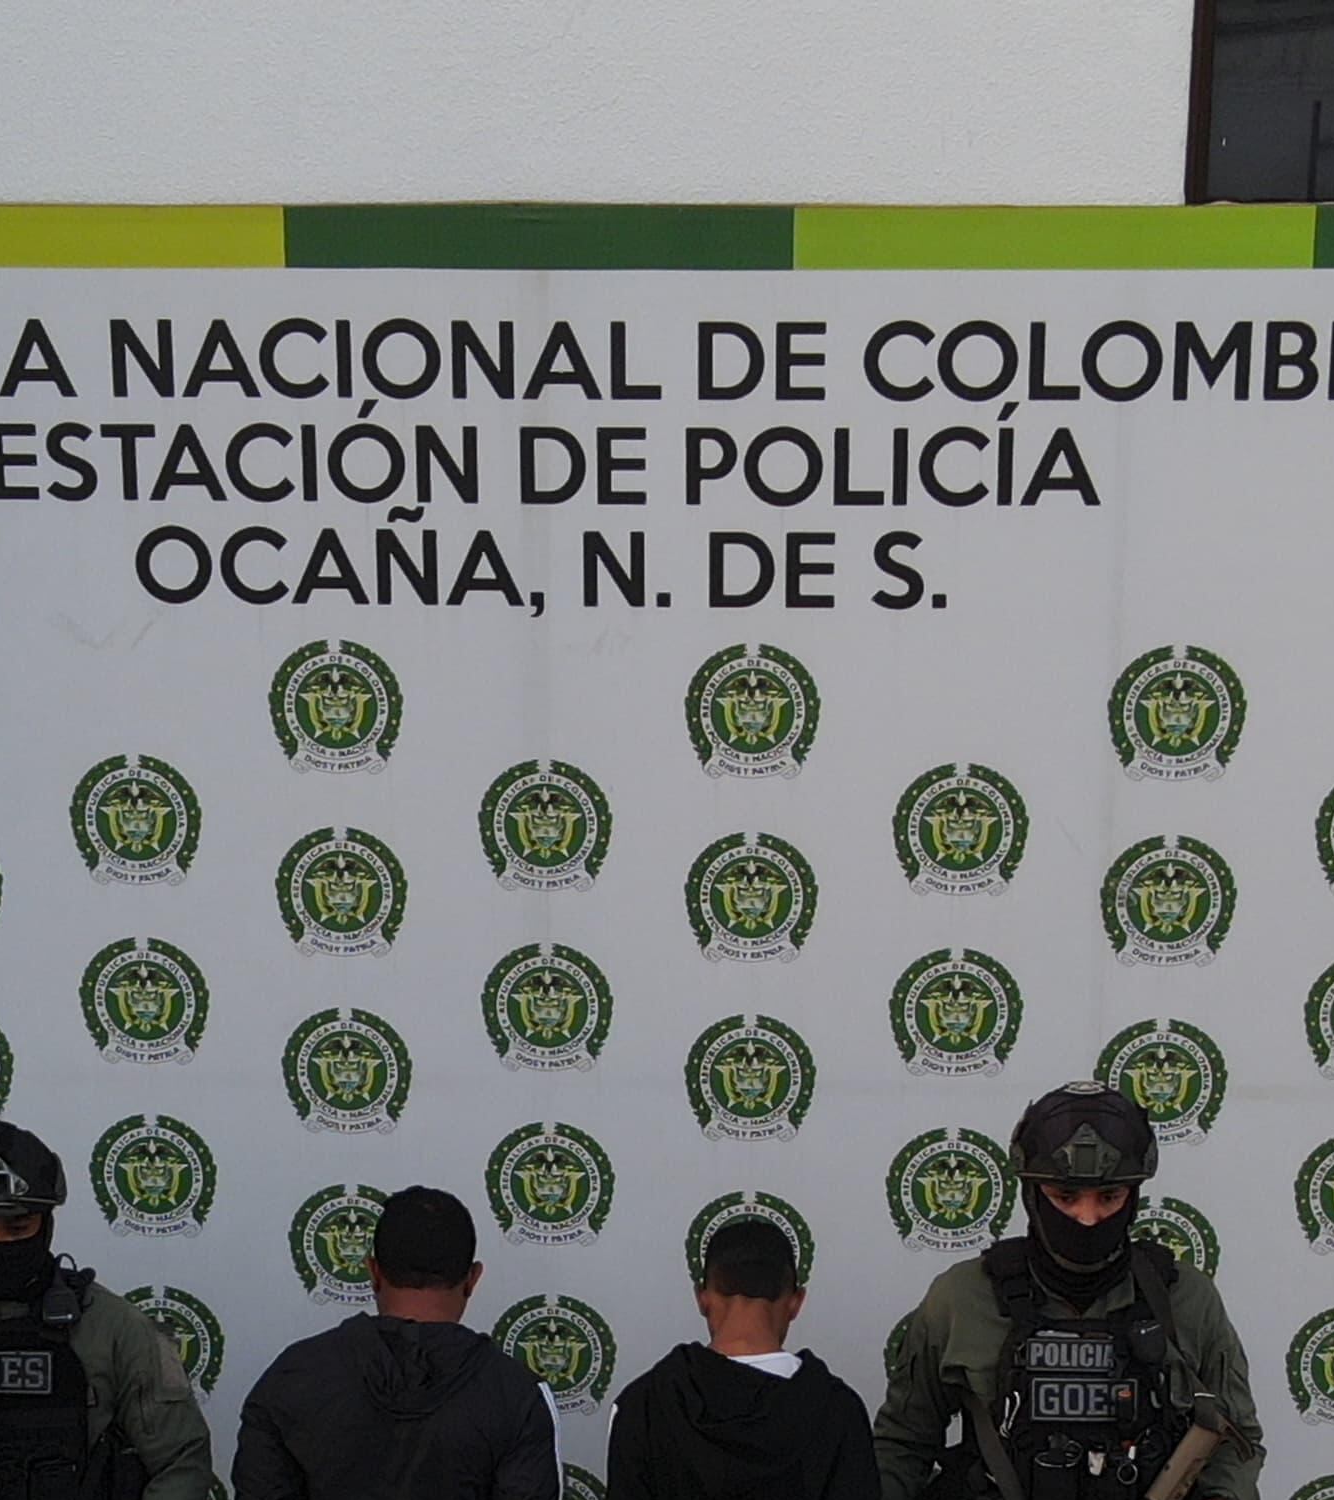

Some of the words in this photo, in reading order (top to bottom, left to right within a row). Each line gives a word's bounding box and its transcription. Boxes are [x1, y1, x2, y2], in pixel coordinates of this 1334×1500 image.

[110, 318, 661, 400] NACIONAL
[698, 322, 826, 400] DE
[520, 427, 646, 504] DE
[686, 402, 1100, 507] POLICÍA
[136, 507, 544, 617] OCAÑA,
[583, 531, 670, 607] N.
[710, 532, 835, 608] DE
[872, 531, 946, 609] S.
[747, 658, 762, 667] DE
[772, 666, 804, 720] COLOMBIA
[1173, 660, 1188, 669] DE
[1198, 668, 1229, 722] COLOMBIA
[956, 778, 971, 786] DE
[981, 785, 1012, 838] COLOMBIA
[541, 957, 555, 966] DE
[565, 965, 597, 1016] COLOMBIA
[146, 1128, 160, 1136] DE
[169, 1135, 202, 1184] COLOMBIA
[544, 1136, 558, 1144] DE
[568, 1143, 599, 1192] COLOMBIA
[1030, 1343, 1114, 1368] POLICIA
